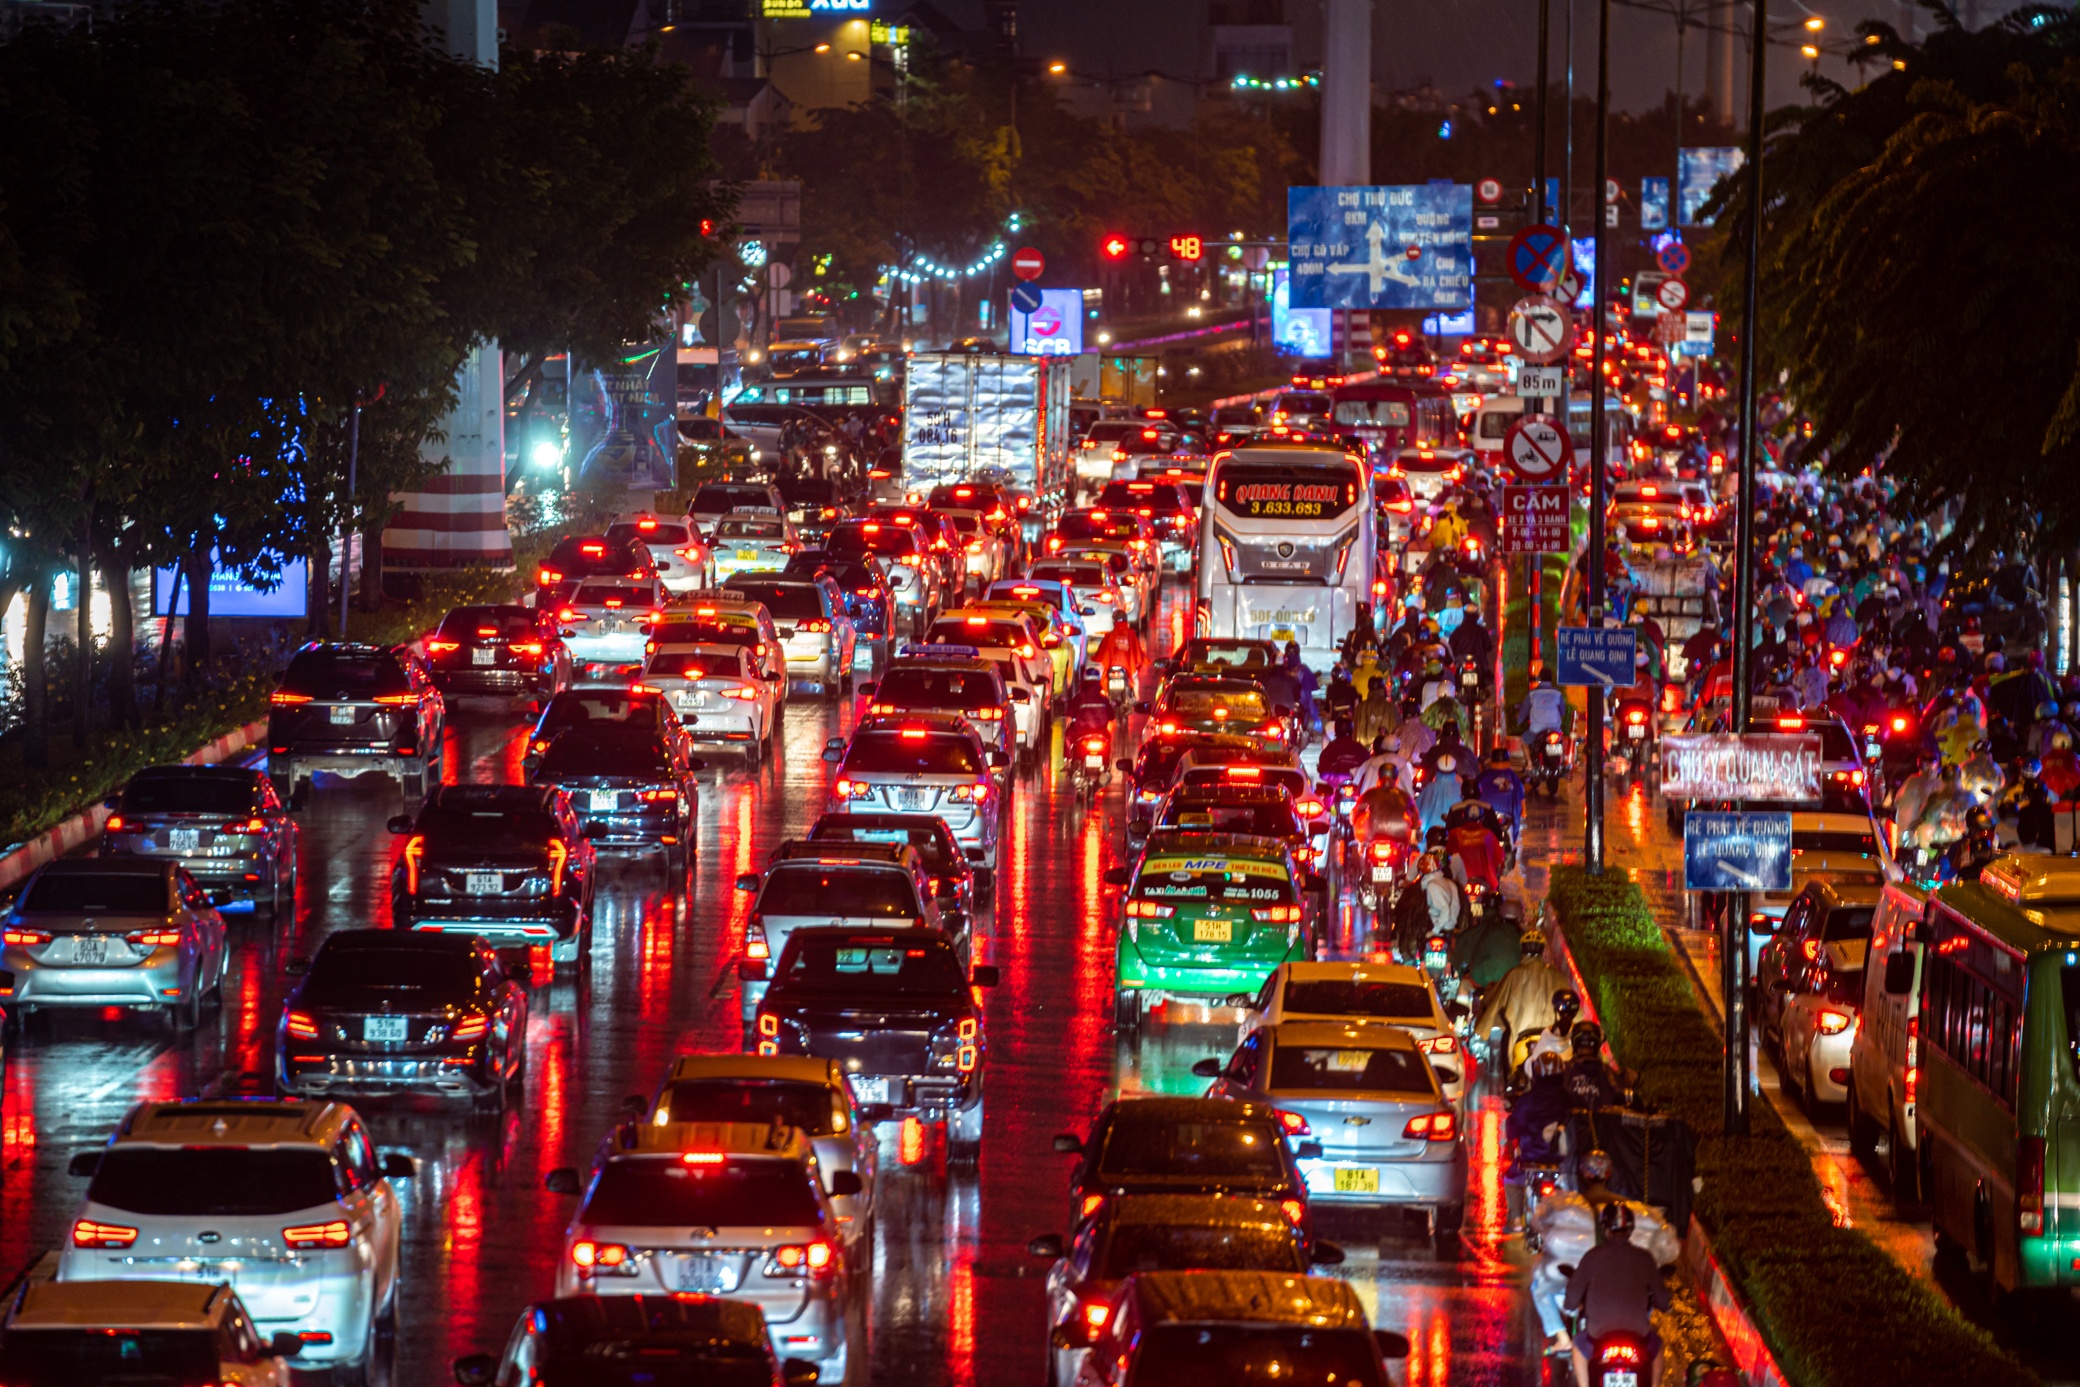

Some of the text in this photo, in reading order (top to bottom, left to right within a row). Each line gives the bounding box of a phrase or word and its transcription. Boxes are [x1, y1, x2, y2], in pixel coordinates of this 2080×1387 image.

[1171, 236, 1201, 260] 48
[1236, 484, 1339, 504] QUANG DANH
[1513, 489, 1560, 511] CẤM
[1580, 649, 1605, 663] QUANG
[1668, 742, 1816, 786] CHÚ Ý QUAN SÁT
[1184, 859, 1229, 871] MPE
[1144, 886, 1165, 896] TAXI
[1251, 887, 1280, 900] 1055
